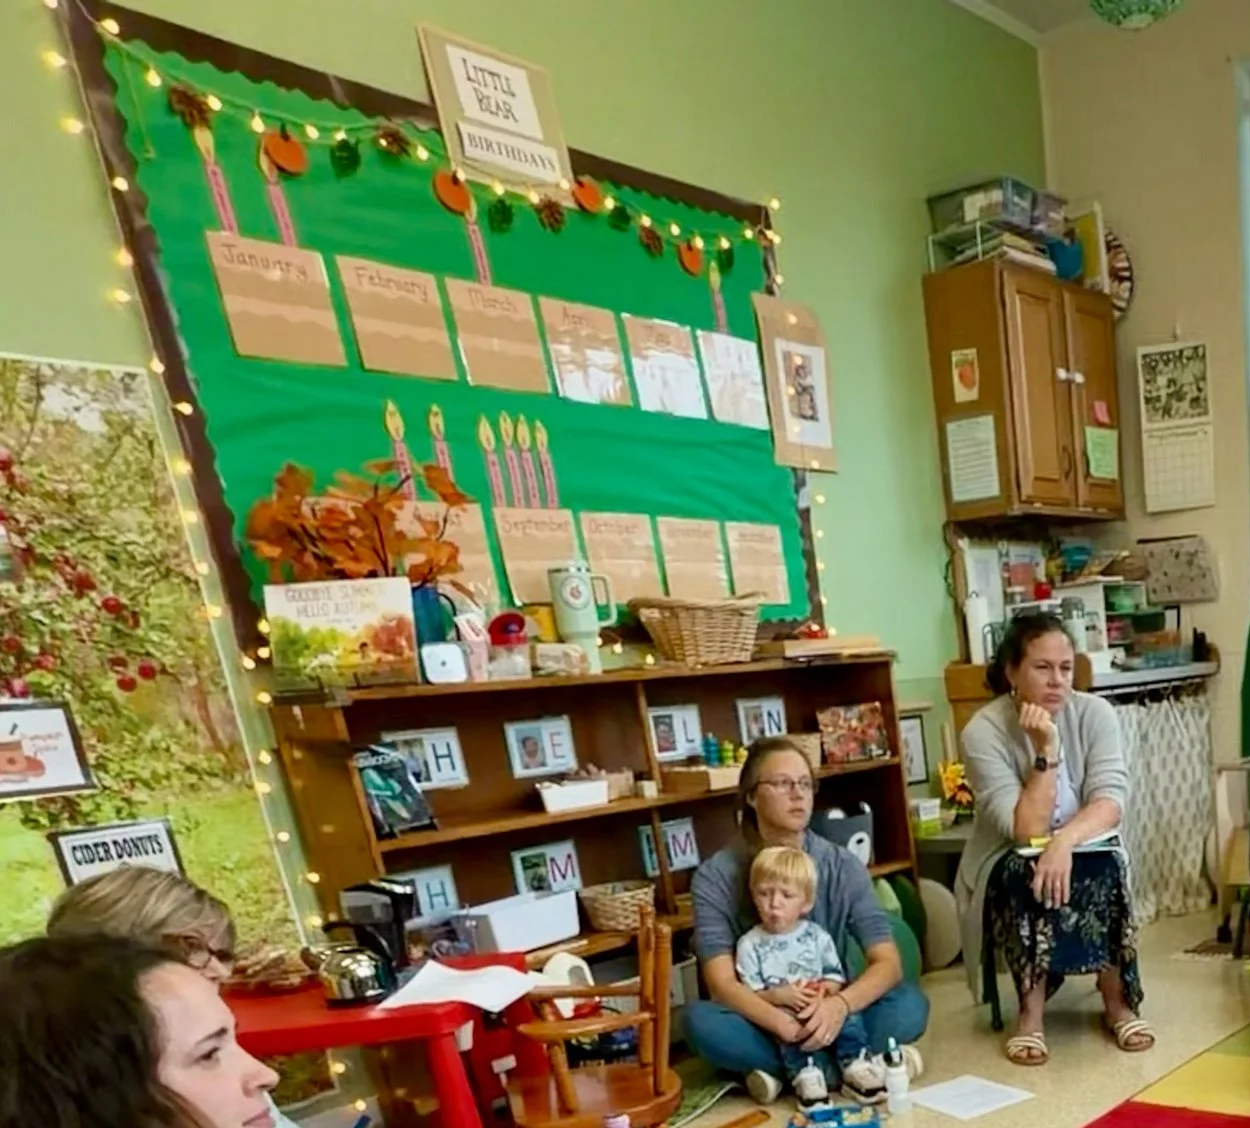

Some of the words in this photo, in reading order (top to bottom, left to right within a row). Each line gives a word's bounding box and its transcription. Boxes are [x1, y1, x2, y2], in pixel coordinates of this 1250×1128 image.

[473, 86, 519, 123] BEAR
[467, 132, 556, 173] BIRTHDAYS
[220, 243, 309, 280] January
[355, 266, 428, 303] February
[467, 287, 518, 313] March
[502, 519, 570, 535] September
[296, 603, 329, 618] HELLO
[682, 716, 695, 743] L
[766, 709, 782, 733] N
[432, 741, 456, 773] H
[550, 731, 567, 760] E
[72, 840, 114, 866] CIDER
[112, 834, 164, 860] DONUTS
[671, 832, 694, 859] M
[550, 853, 575, 883] M
[425, 880, 450, 910] H
